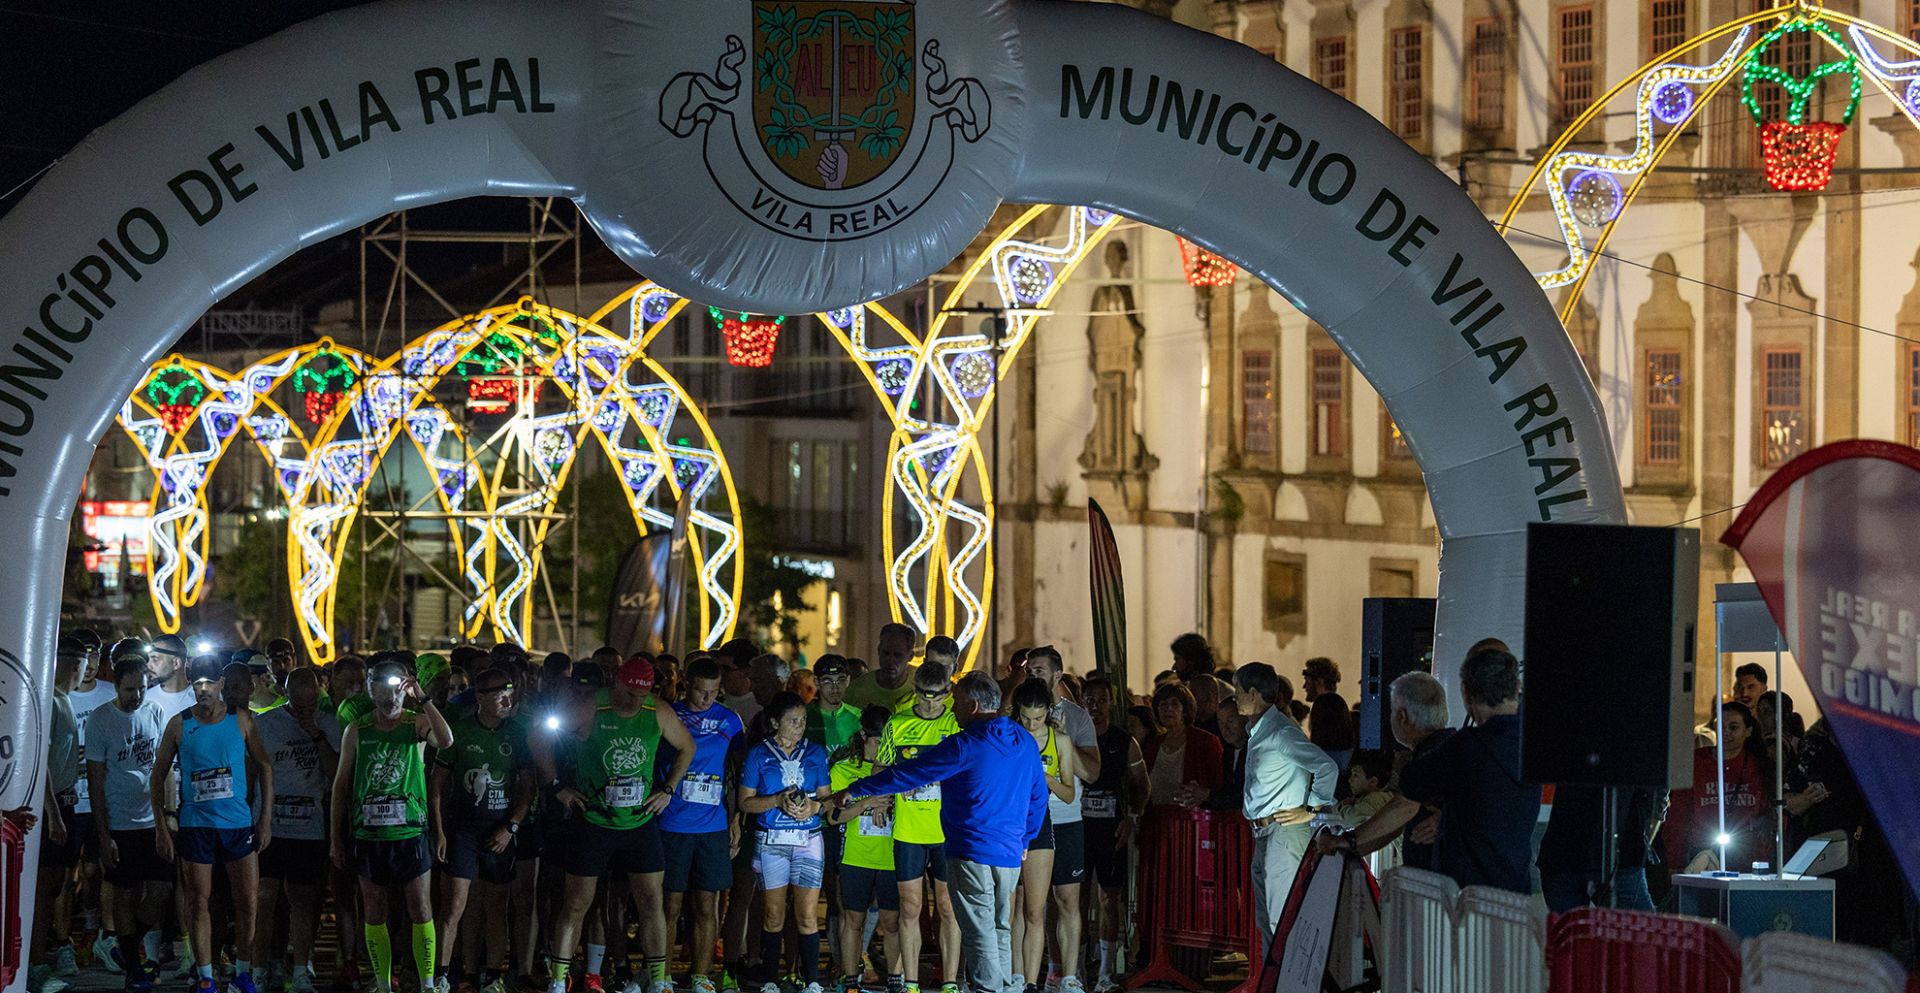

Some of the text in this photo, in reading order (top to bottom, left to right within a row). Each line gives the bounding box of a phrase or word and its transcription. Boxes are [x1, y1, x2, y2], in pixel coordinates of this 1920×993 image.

[167, 142, 259, 227] DE
[255, 81, 402, 172] VILA
[414, 57, 556, 125] REAL
[751, 188, 909, 234] VILA REAL
[1355, 187, 1441, 268] DE
[1431, 253, 1528, 385] VILA
[1503, 382, 1588, 522] REAL
[206, 780, 217, 788] 25
[697, 783, 710, 792] 201
[488, 789, 505, 799] CTM
[622, 787, 632, 795] 99
[377, 805, 390, 813] 100
